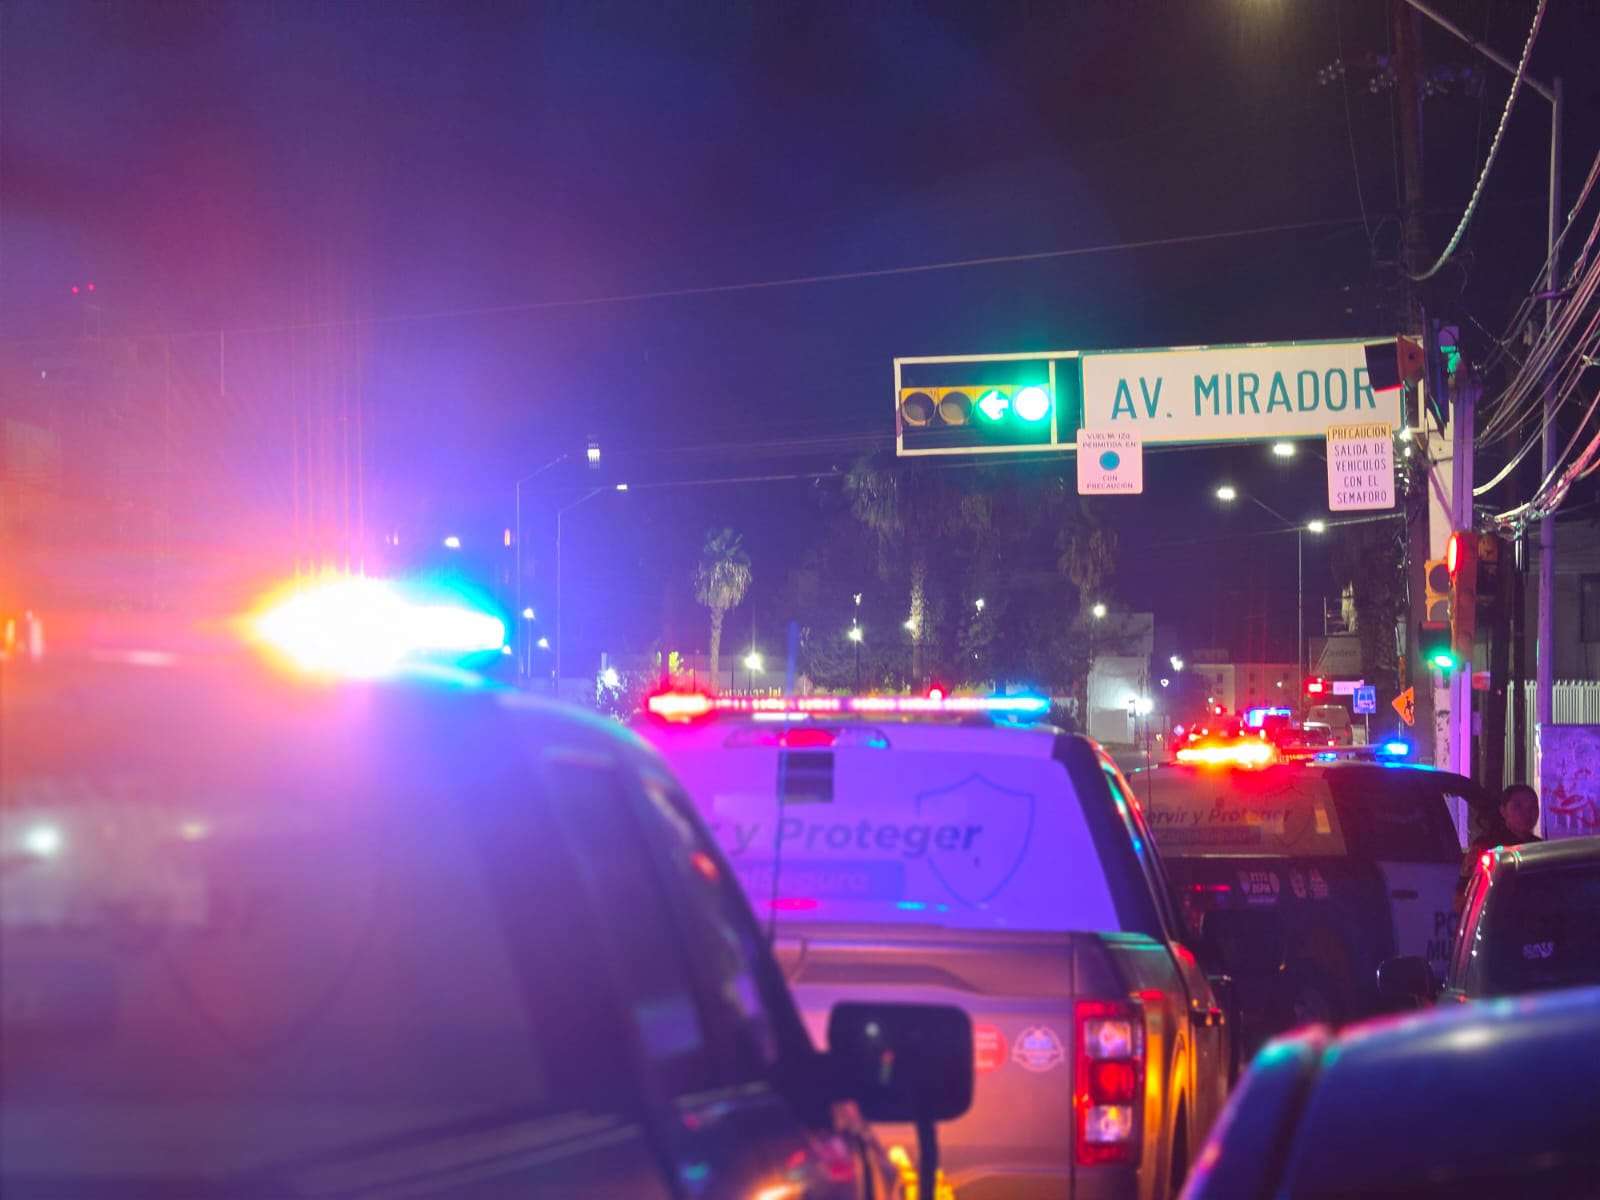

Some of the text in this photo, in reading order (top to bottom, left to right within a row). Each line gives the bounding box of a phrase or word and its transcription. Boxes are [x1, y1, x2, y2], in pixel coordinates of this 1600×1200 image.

[1111, 367, 1377, 420] AV. MIRADOR
[1334, 442, 1386, 457] SALIDA DE
[1335, 458, 1387, 473] VEHICULOS
[1344, 474, 1380, 488] CON EL
[1336, 491, 1387, 505] SEMAFORO
[728, 815, 984, 860] y Proteger
